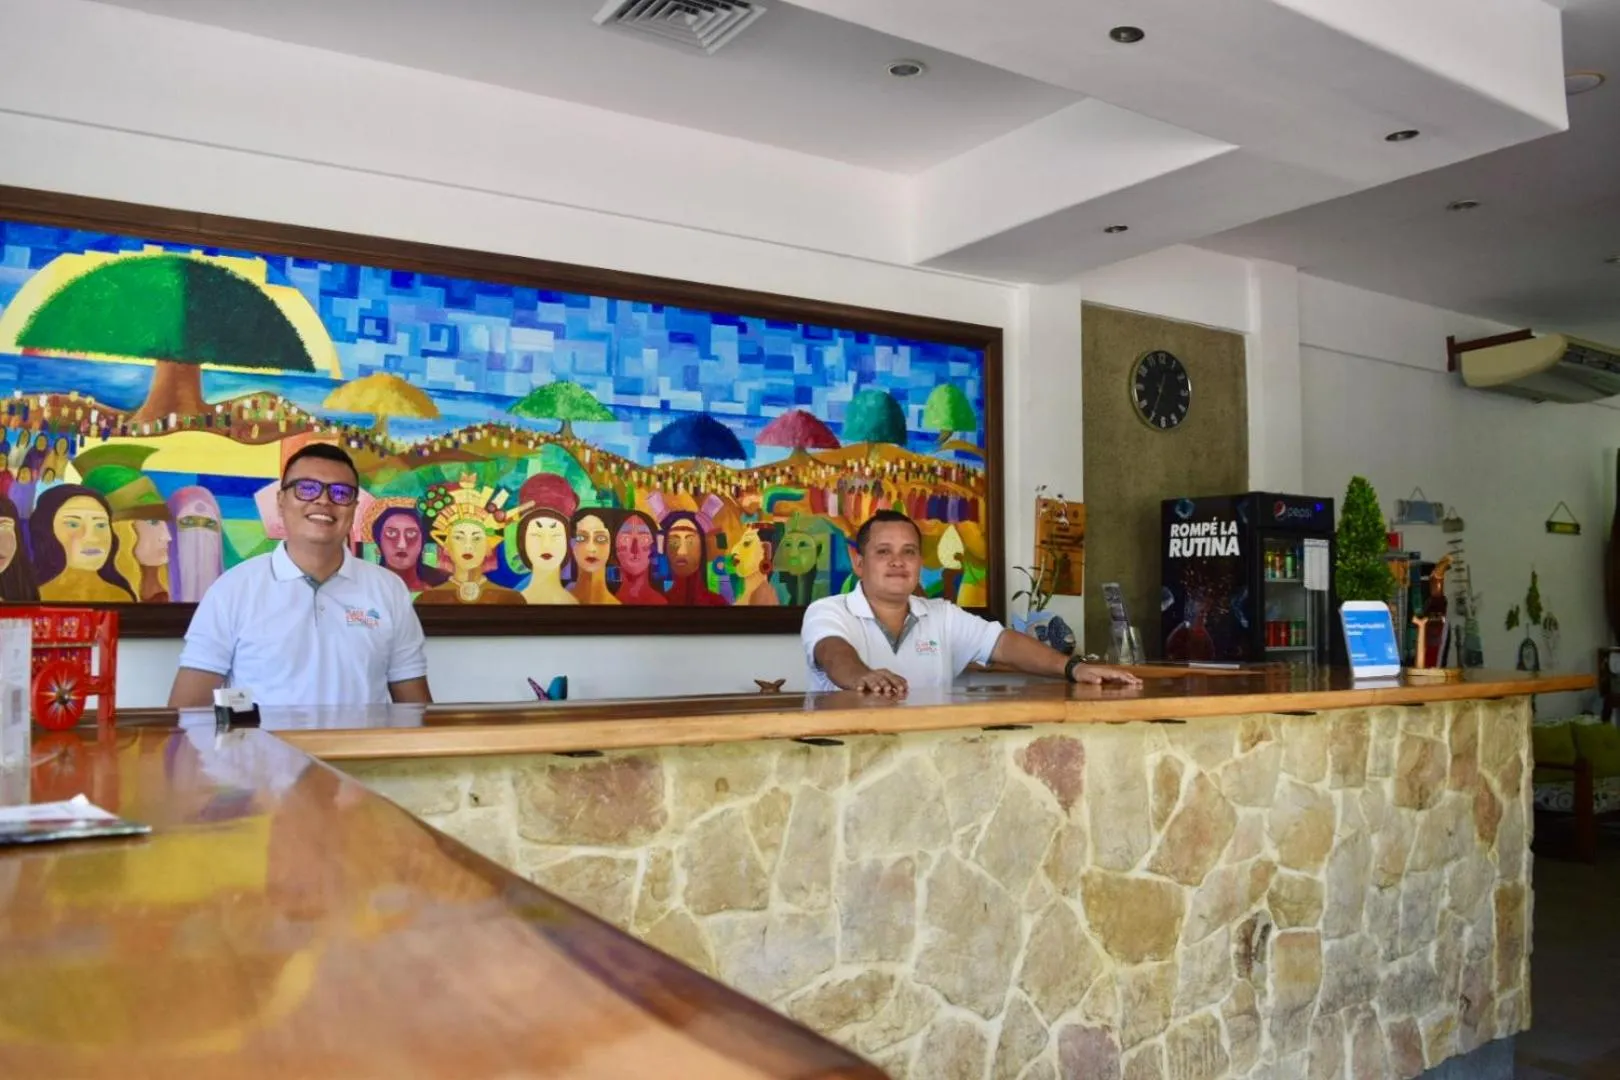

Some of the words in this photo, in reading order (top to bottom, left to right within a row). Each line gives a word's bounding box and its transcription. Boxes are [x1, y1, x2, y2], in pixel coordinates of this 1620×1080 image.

[1170, 516, 1218, 537] ROMPÉ
[1219, 520, 1238, 536] LA
[1169, 536, 1241, 558] RUTINA
